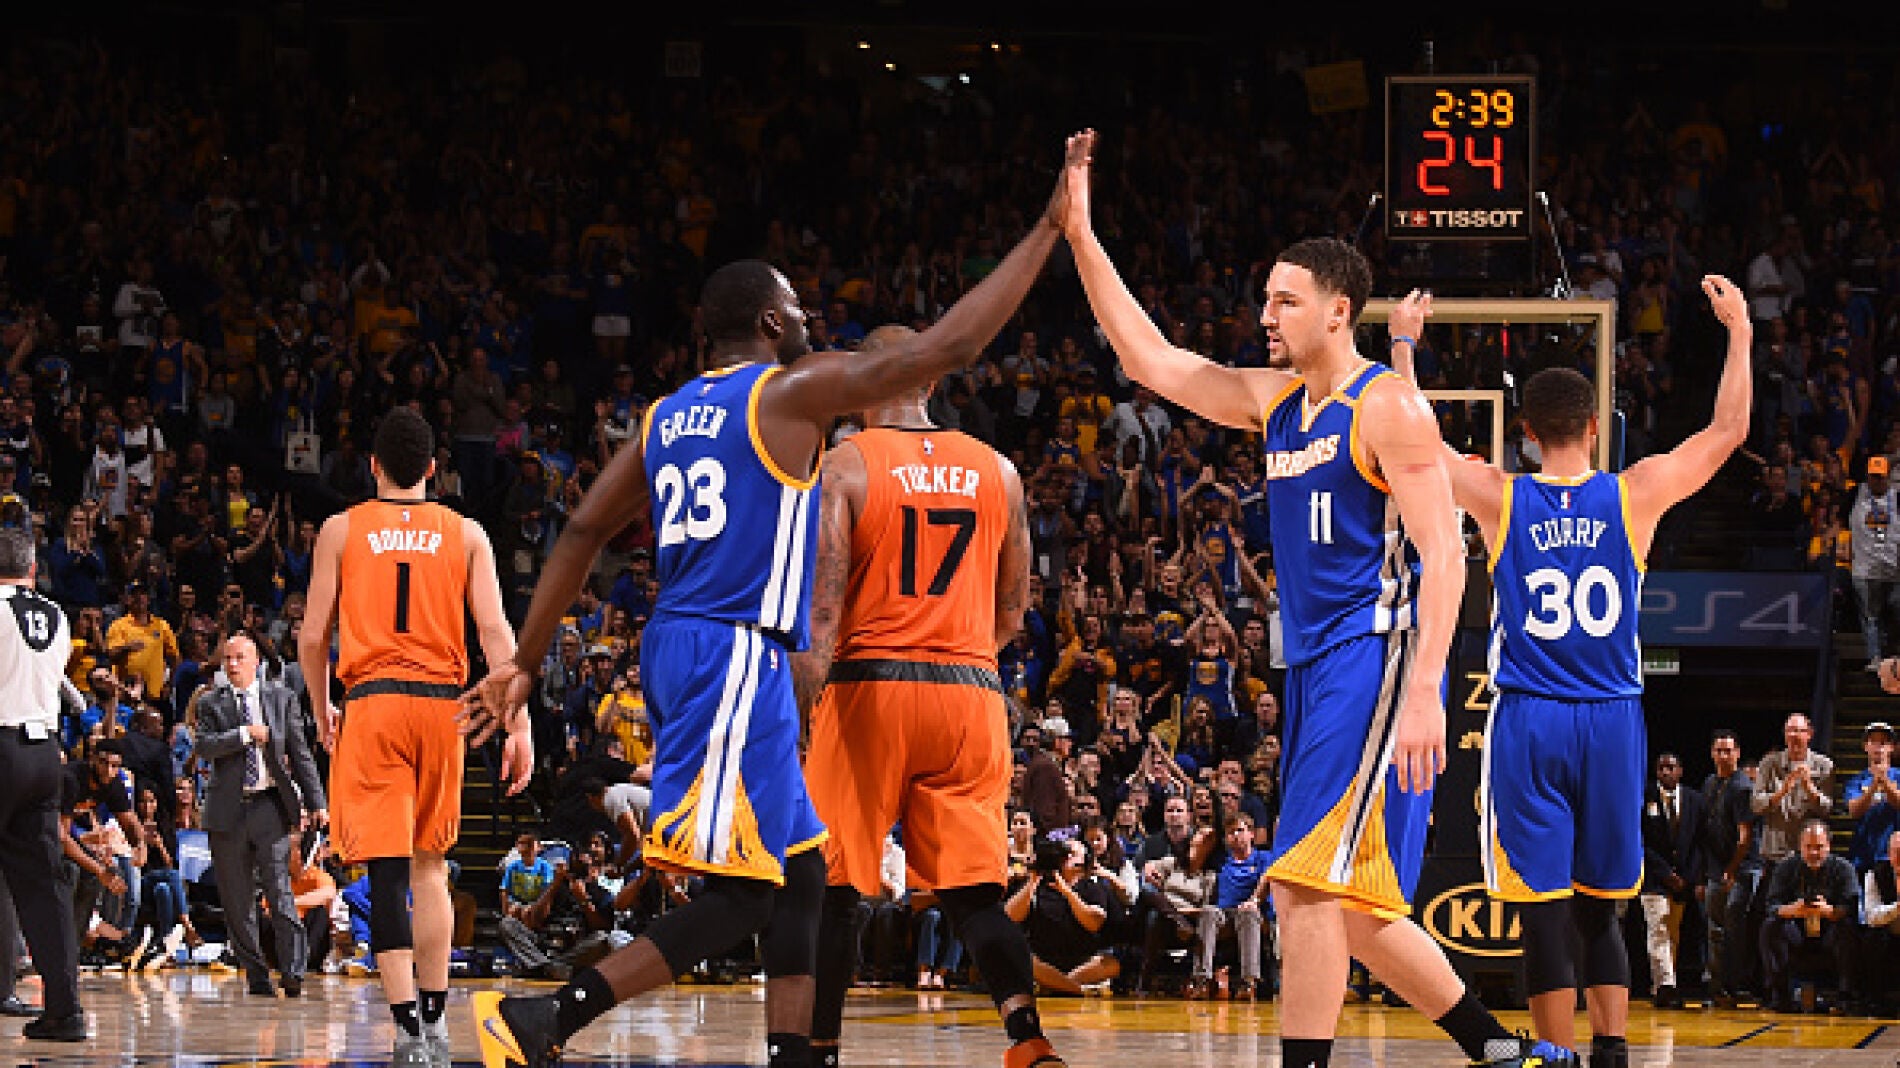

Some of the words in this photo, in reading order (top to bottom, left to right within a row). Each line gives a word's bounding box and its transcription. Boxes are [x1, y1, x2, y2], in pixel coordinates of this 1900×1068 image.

[1431, 89, 1514, 128] 2:39
[1417, 130, 1504, 196] 24
[1429, 210, 1523, 227] TISSOT
[659, 405, 727, 448] GREEN
[655, 457, 727, 547] 23
[891, 464, 980, 499] TUCKER
[1309, 490, 1334, 544] 11
[1529, 518, 1608, 553] CURRY
[367, 528, 442, 556] BOOKER
[900, 506, 976, 597] 17
[395, 562, 410, 633] 1
[1523, 565, 1622, 640] 30
[24, 610, 49, 640] 13
